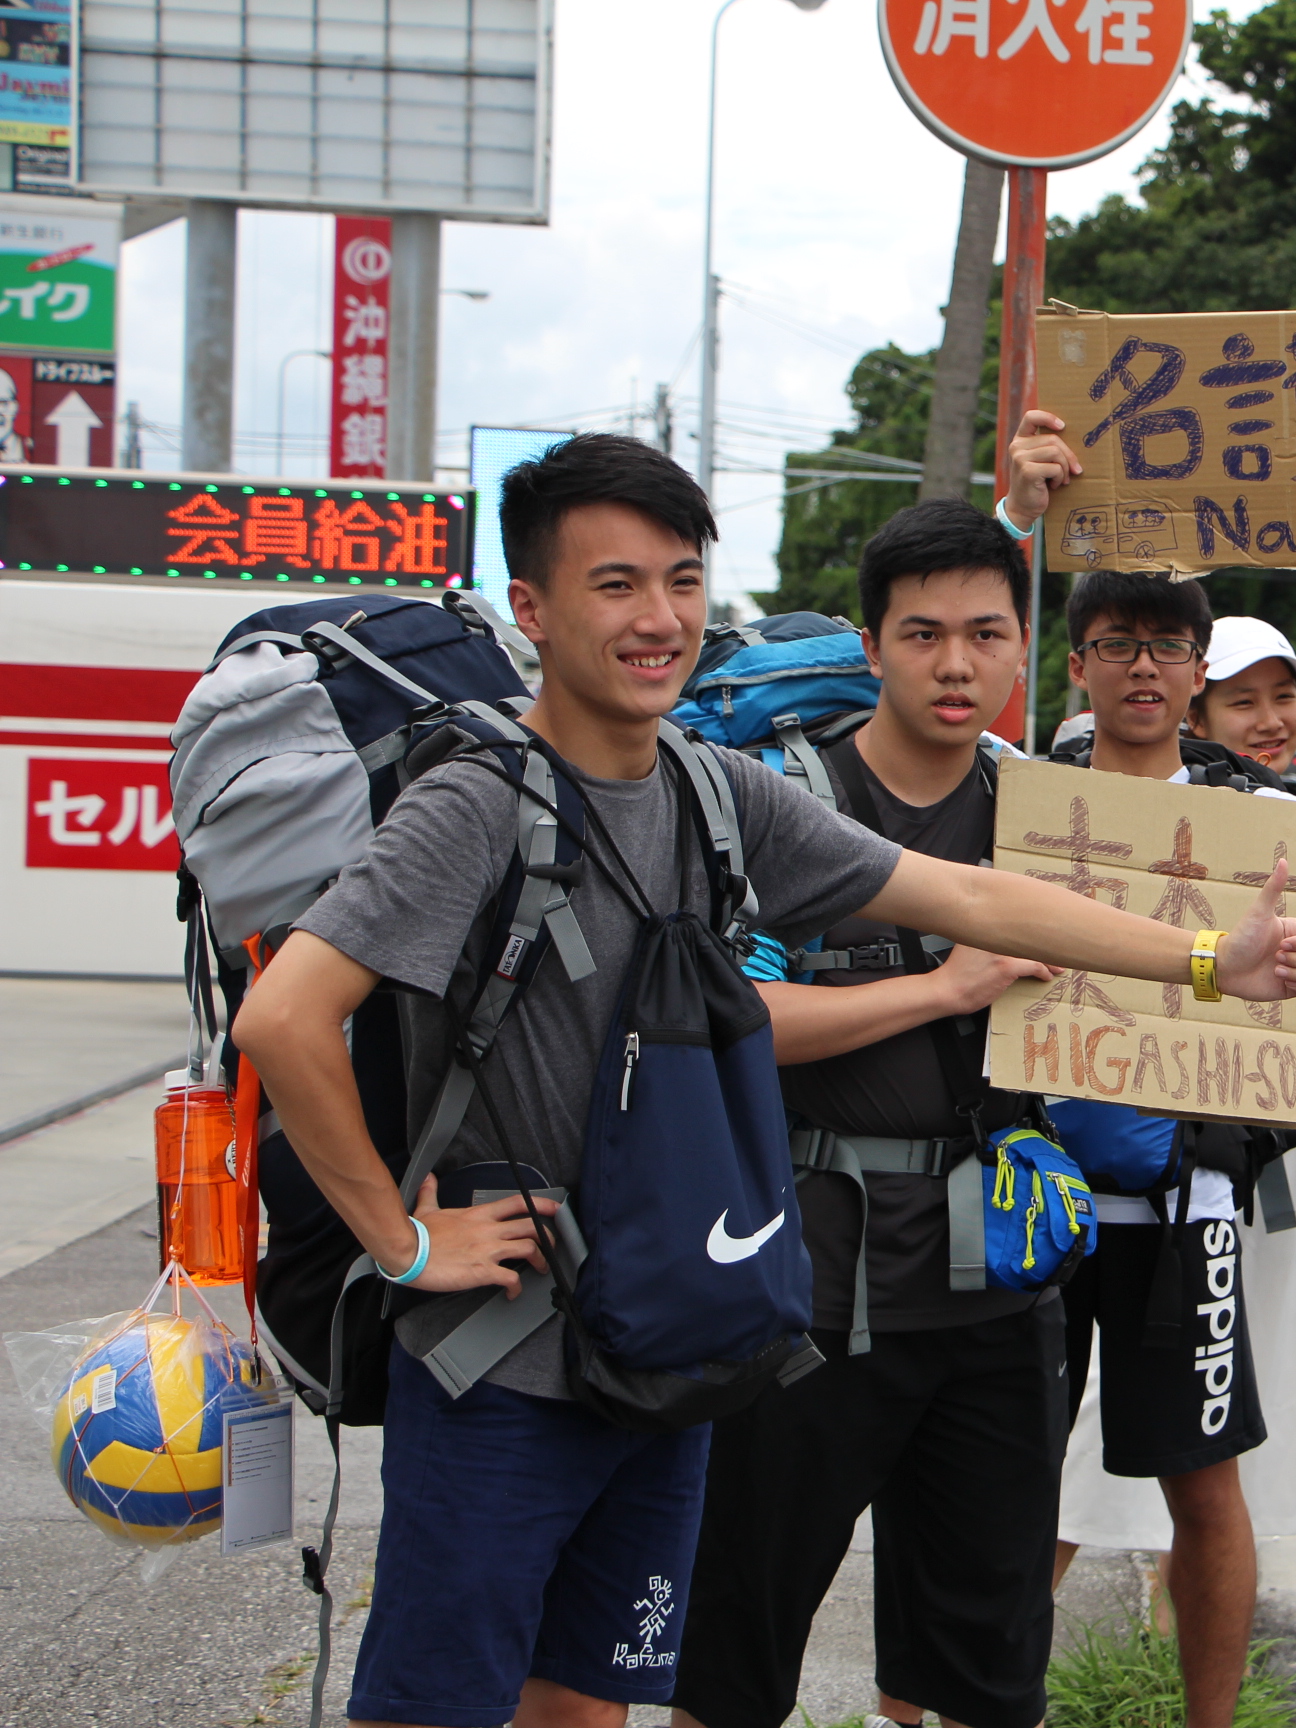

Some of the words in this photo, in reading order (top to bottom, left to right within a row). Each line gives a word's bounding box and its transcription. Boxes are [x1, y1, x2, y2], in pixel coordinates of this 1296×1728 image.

[340, 294, 388, 479] 沖縄銀
[166, 493, 448, 574] 会員給油
[33, 780, 180, 848] セル
[1194, 1219, 1236, 1436] adidas
[612, 1642, 676, 1669] Kahuna
